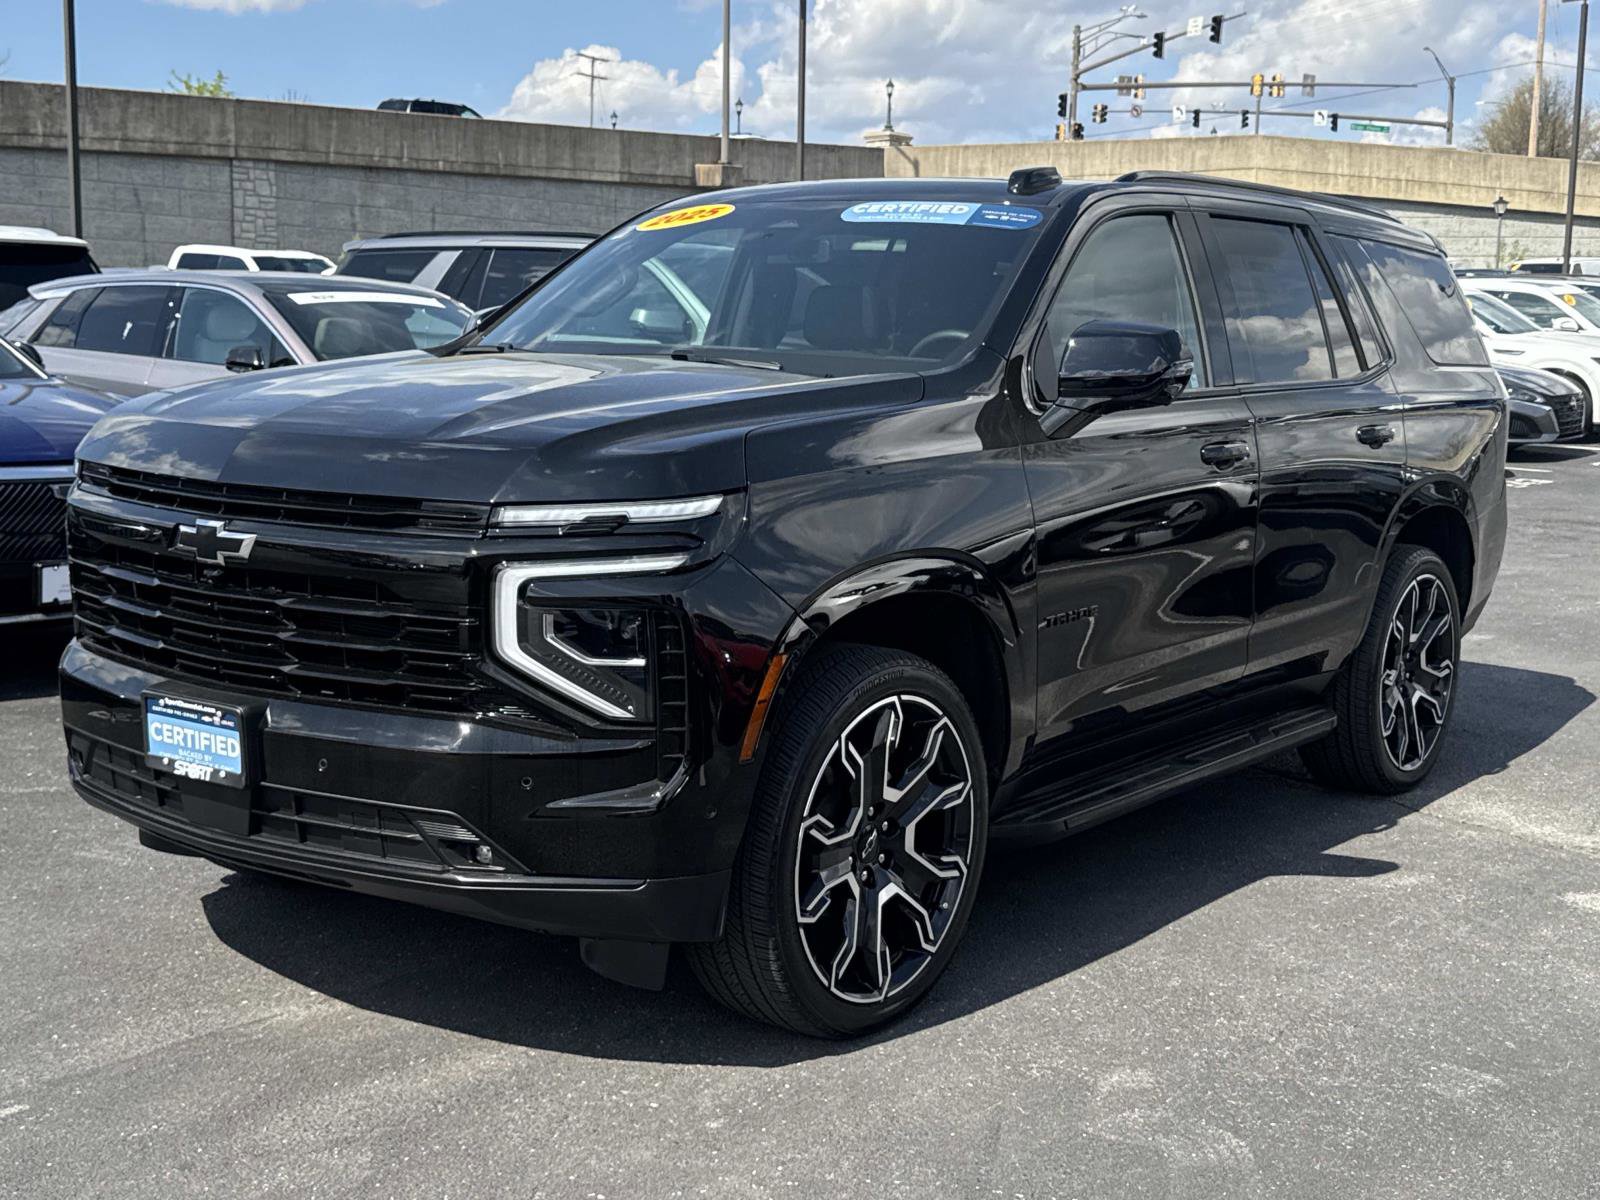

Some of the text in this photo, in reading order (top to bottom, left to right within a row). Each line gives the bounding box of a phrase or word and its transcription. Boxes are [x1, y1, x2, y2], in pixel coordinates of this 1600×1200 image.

[645, 205, 728, 228] 2025
[851, 203, 970, 214] CERTIFIED
[150, 721, 241, 758] CERTIFIED
